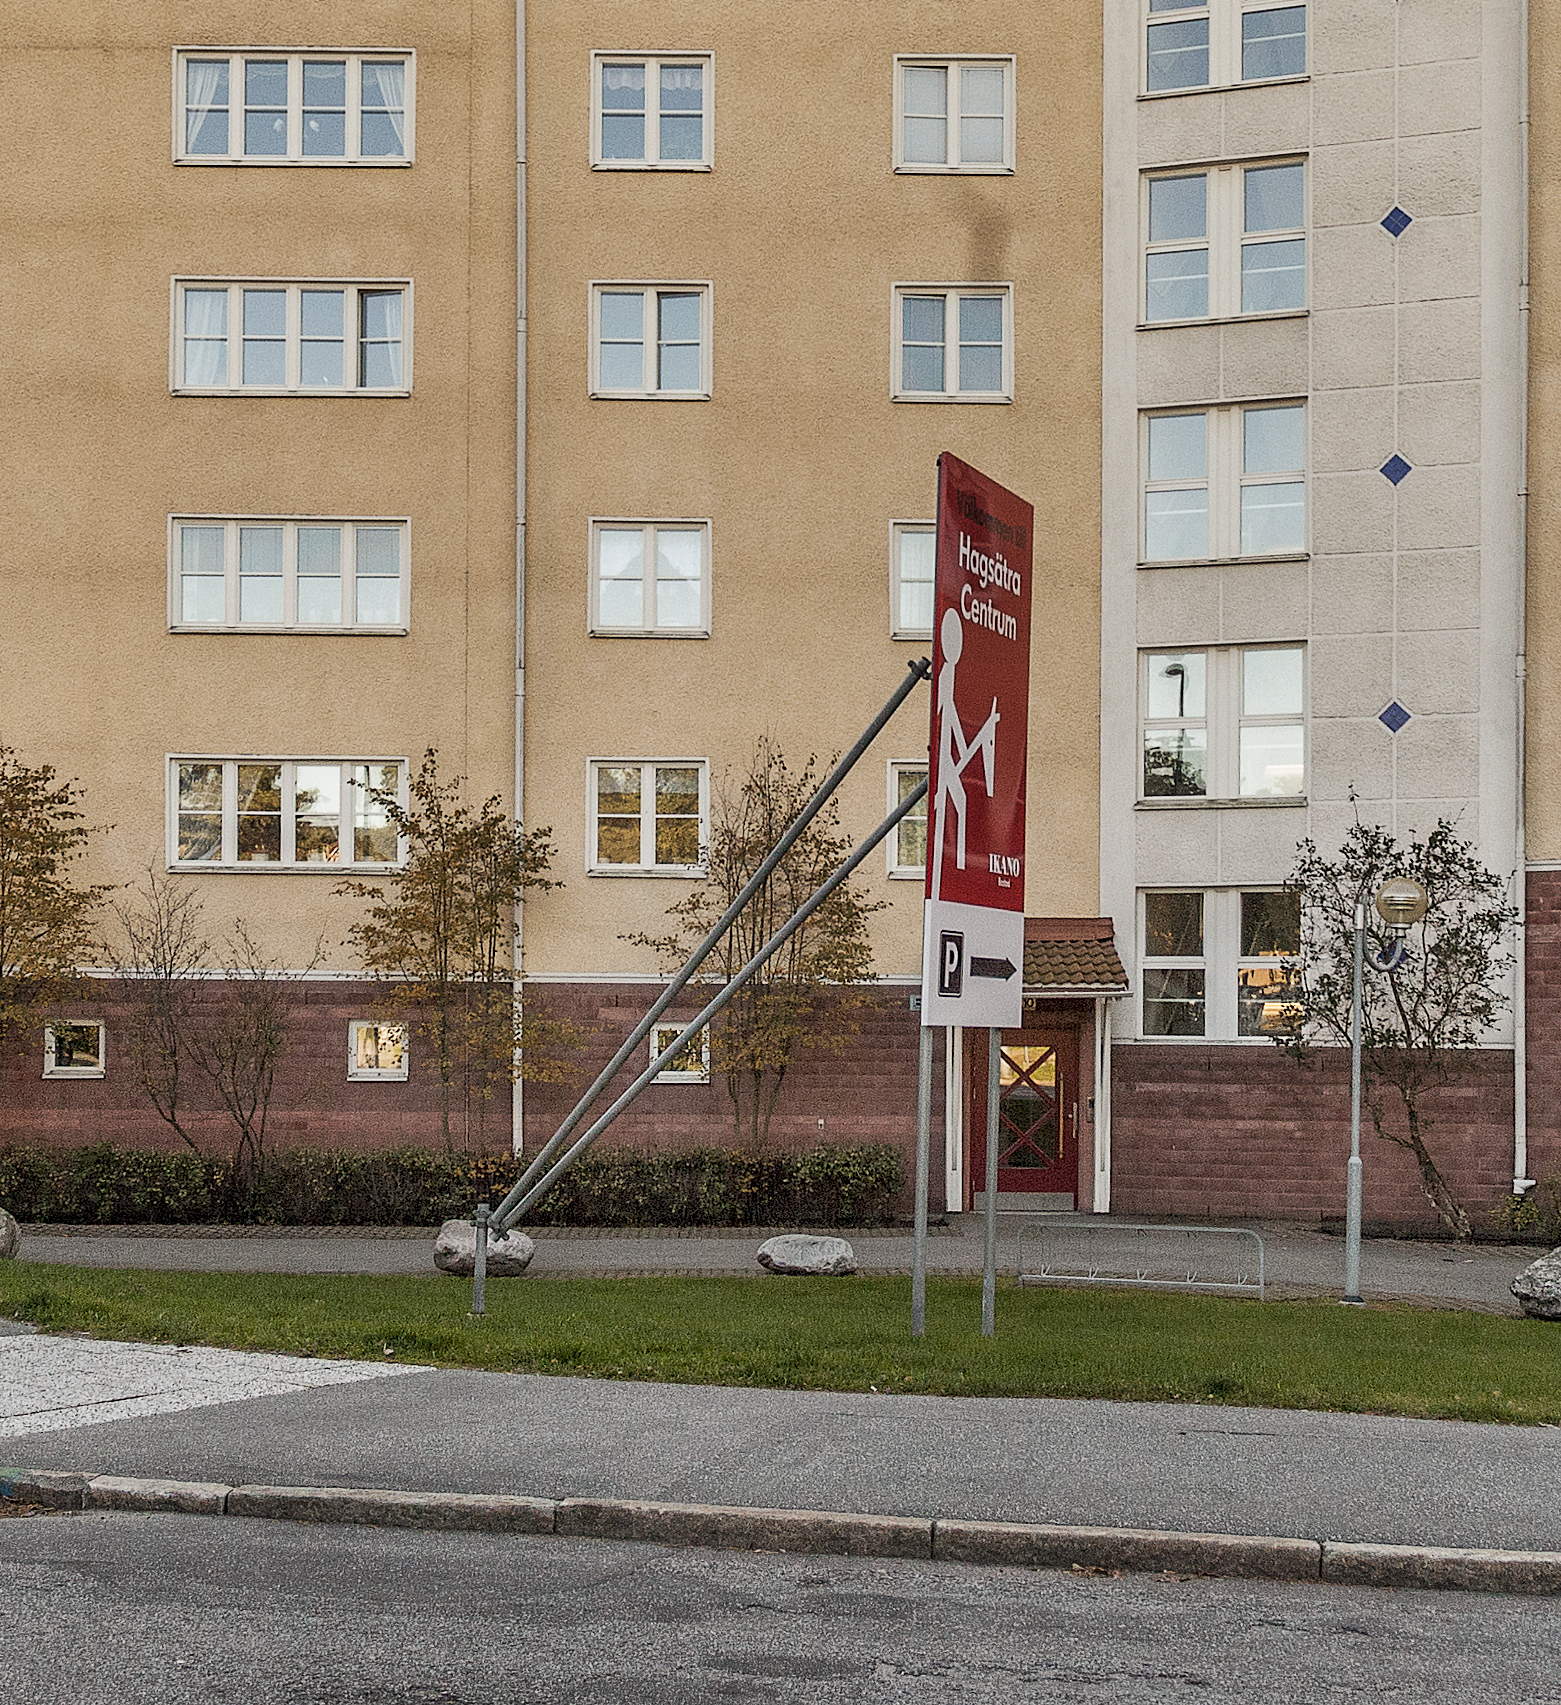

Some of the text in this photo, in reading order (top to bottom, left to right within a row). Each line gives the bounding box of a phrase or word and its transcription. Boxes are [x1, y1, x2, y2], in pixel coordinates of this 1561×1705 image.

[958, 531, 1021, 596] Hagsätra
[960, 583, 1017, 641] Centrum
[988, 853, 1020, 877] IKANO
[944, 941, 959, 988] P
